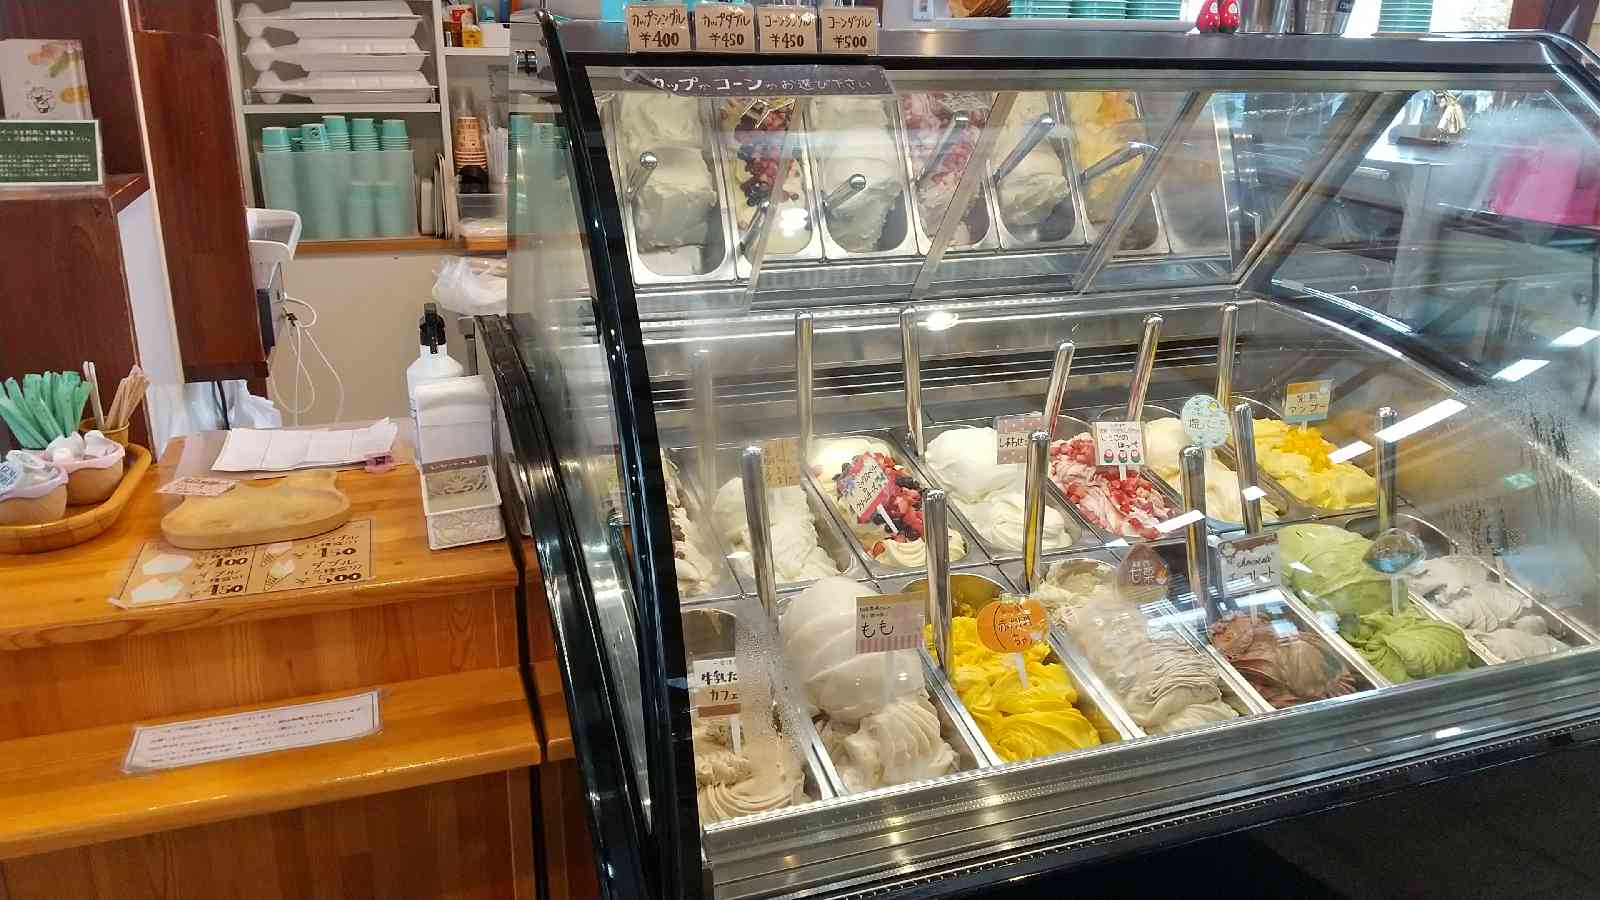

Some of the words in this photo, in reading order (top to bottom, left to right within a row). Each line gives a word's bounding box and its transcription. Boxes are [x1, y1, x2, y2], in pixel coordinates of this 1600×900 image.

[703, 11, 751, 28] カップダブル
[827, 15, 872, 30] コーンダブル
[640, 31, 680, 48] ¥400
[709, 32, 745, 48] ¥450
[769, 33, 805, 48] ¥450
[833, 35, 868, 49] ¥500
[861, 619, 894, 638] もも
